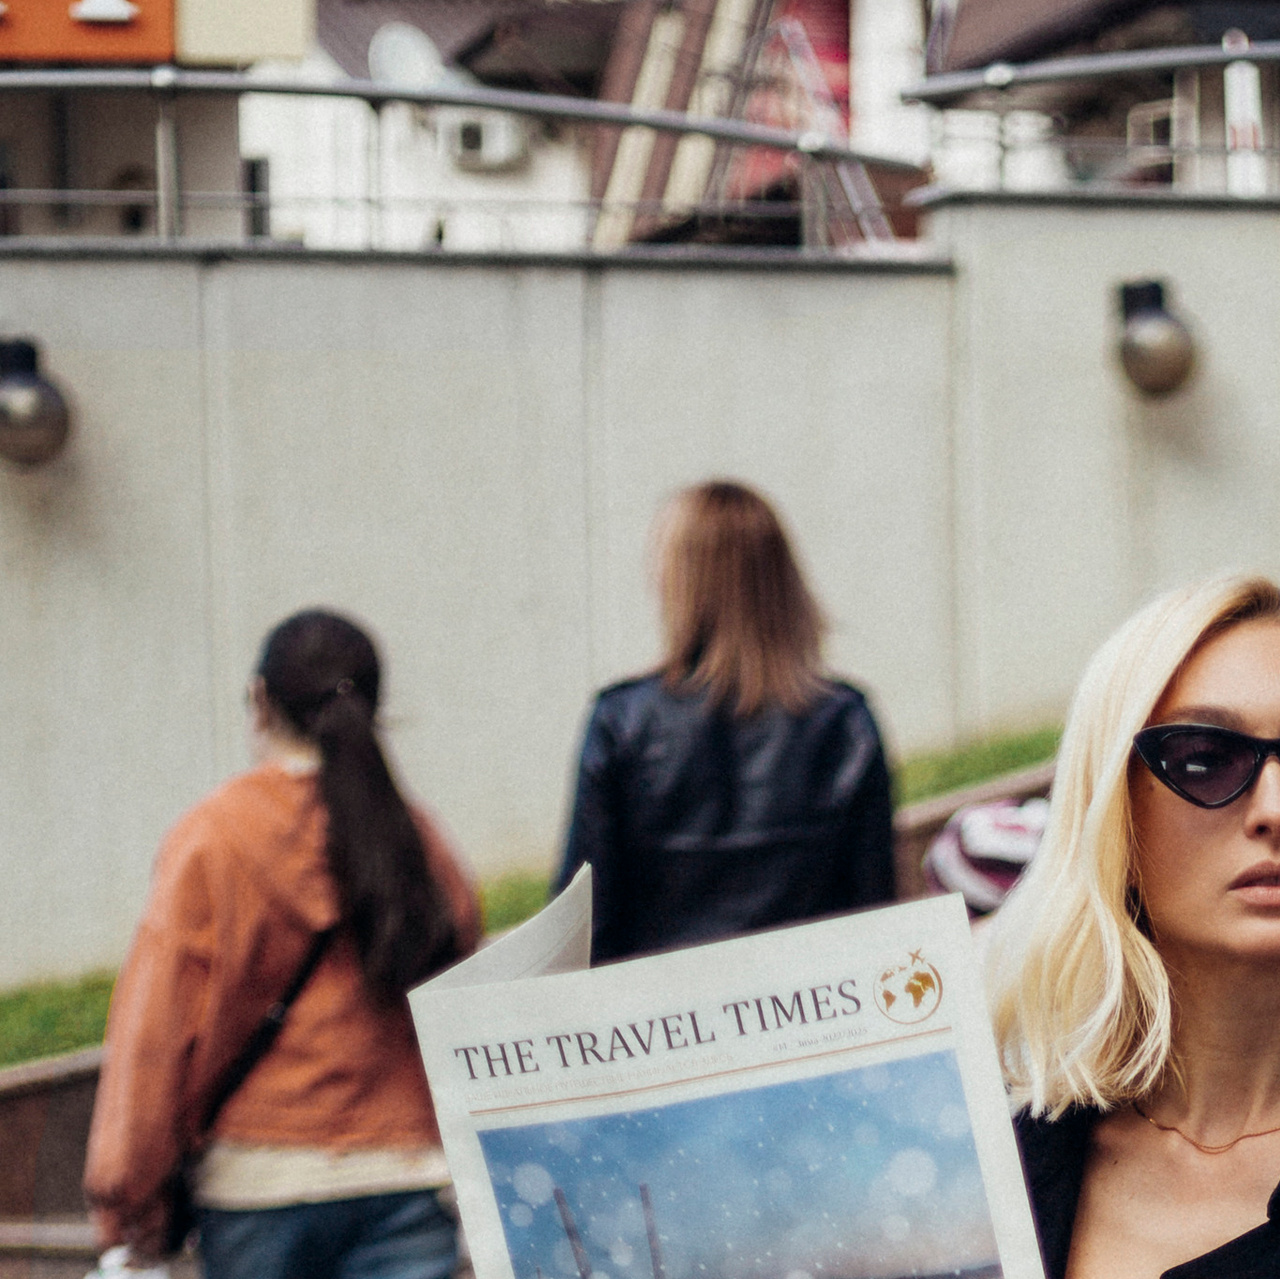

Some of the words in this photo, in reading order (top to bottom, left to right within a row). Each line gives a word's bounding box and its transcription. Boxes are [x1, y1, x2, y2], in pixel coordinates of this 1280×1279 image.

[453, 1039, 540, 1080] THE
[546, 1011, 716, 1068] TRAVEL
[722, 981, 861, 1036] TIMES
